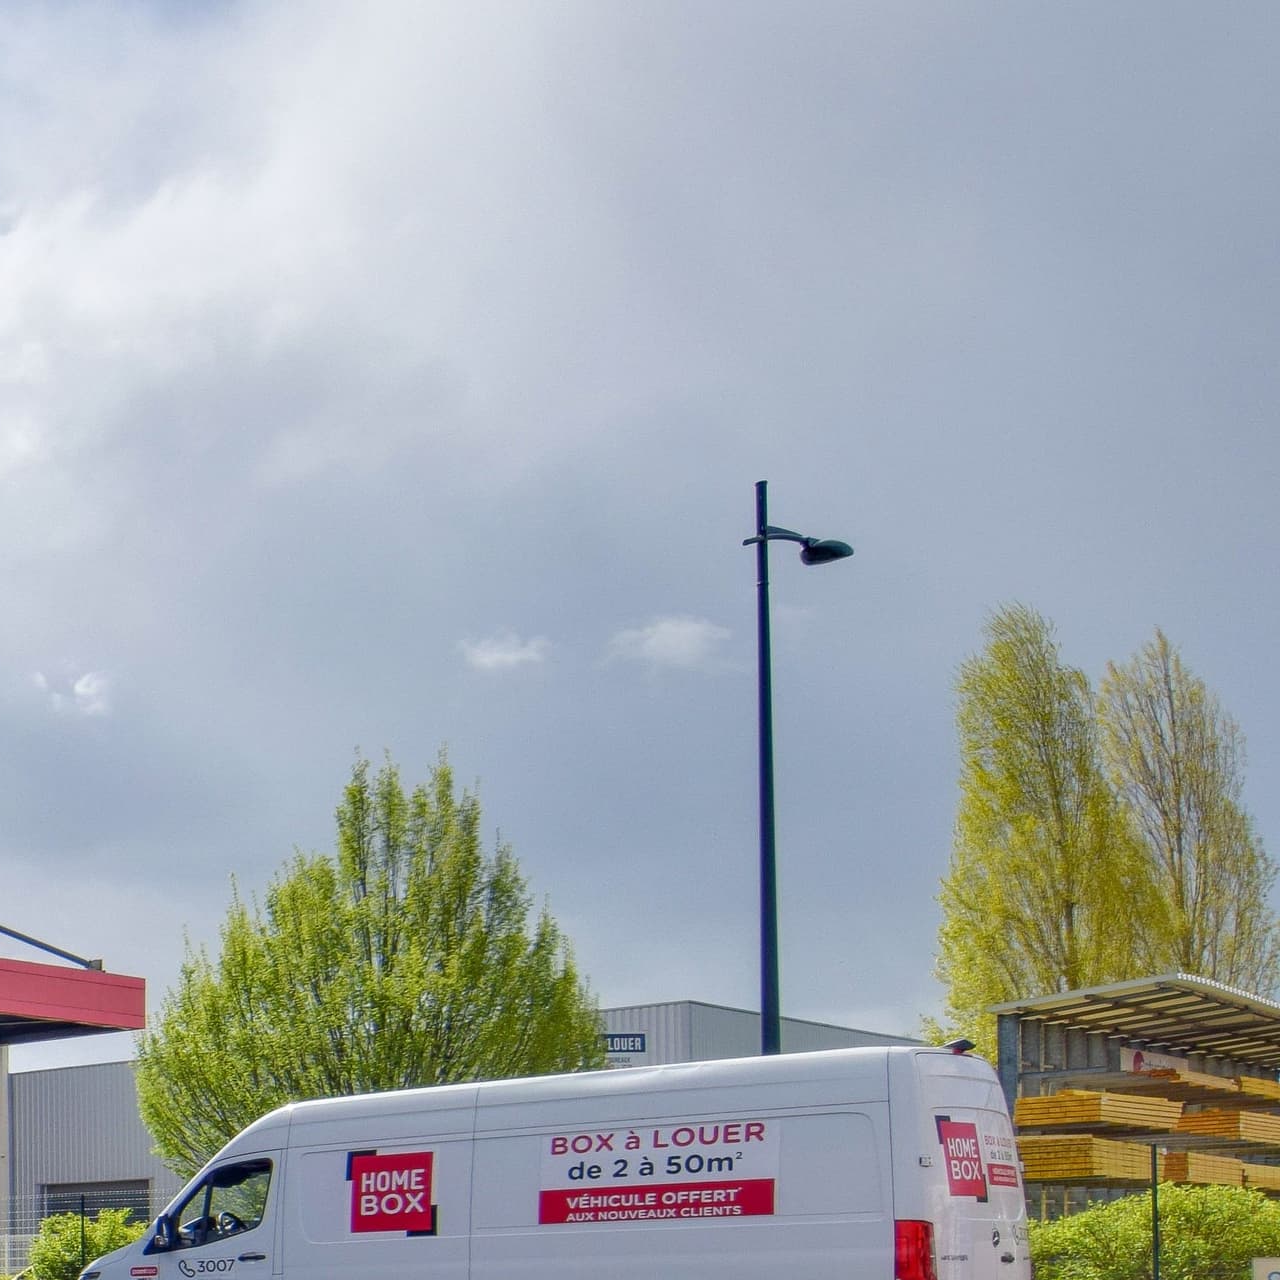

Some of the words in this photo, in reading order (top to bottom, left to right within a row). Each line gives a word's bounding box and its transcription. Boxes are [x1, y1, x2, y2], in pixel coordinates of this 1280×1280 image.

[608, 1037, 642, 1051] LOUER
[551, 1133, 614, 1155] BOX
[624, 1130, 640, 1150] à
[653, 1122, 766, 1149] LOUER
[947, 1137, 978, 1158] HOME
[568, 1161, 602, 1180] de
[612, 1159, 628, 1178] 2
[638, 1157, 654, 1176] à
[951, 1160, 981, 1180] BOX
[361, 1168, 425, 1192] HOME
[360, 1192, 424, 1216] BOX
[566, 1191, 657, 1209] VÉHICULE
[566, 1212, 594, 1222] AUX
[598, 1208, 676, 1221] NOUVEAUX
[680, 1206, 742, 1217] CLIENTS
[197, 1259, 236, 1273] 3007
